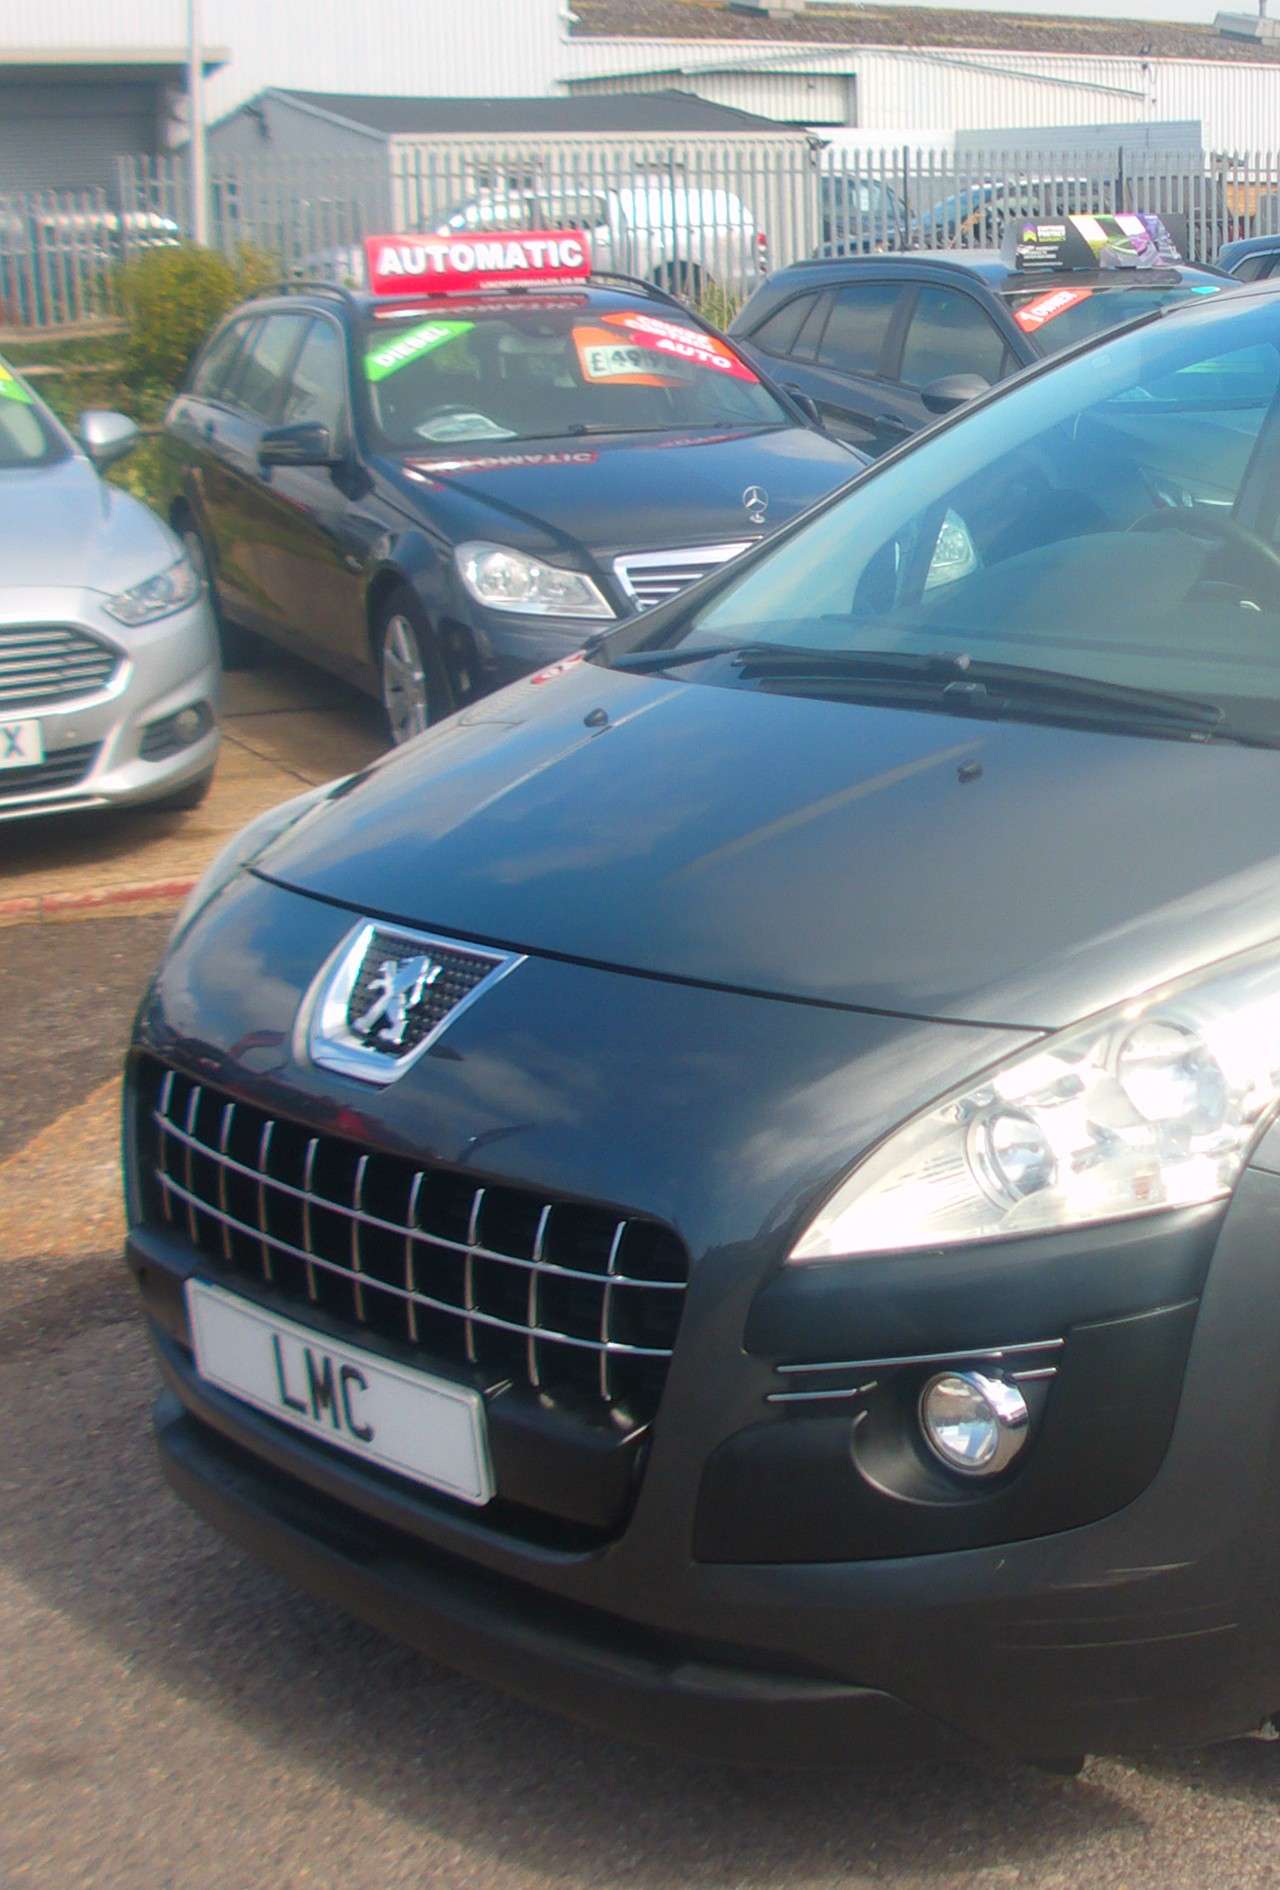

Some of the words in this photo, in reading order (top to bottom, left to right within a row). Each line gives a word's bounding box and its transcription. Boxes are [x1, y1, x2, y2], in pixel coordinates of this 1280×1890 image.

[376, 239, 584, 276] AUTOMATIC
[656, 339, 732, 369] AUTO
[271, 1333, 375, 1444] LMC
